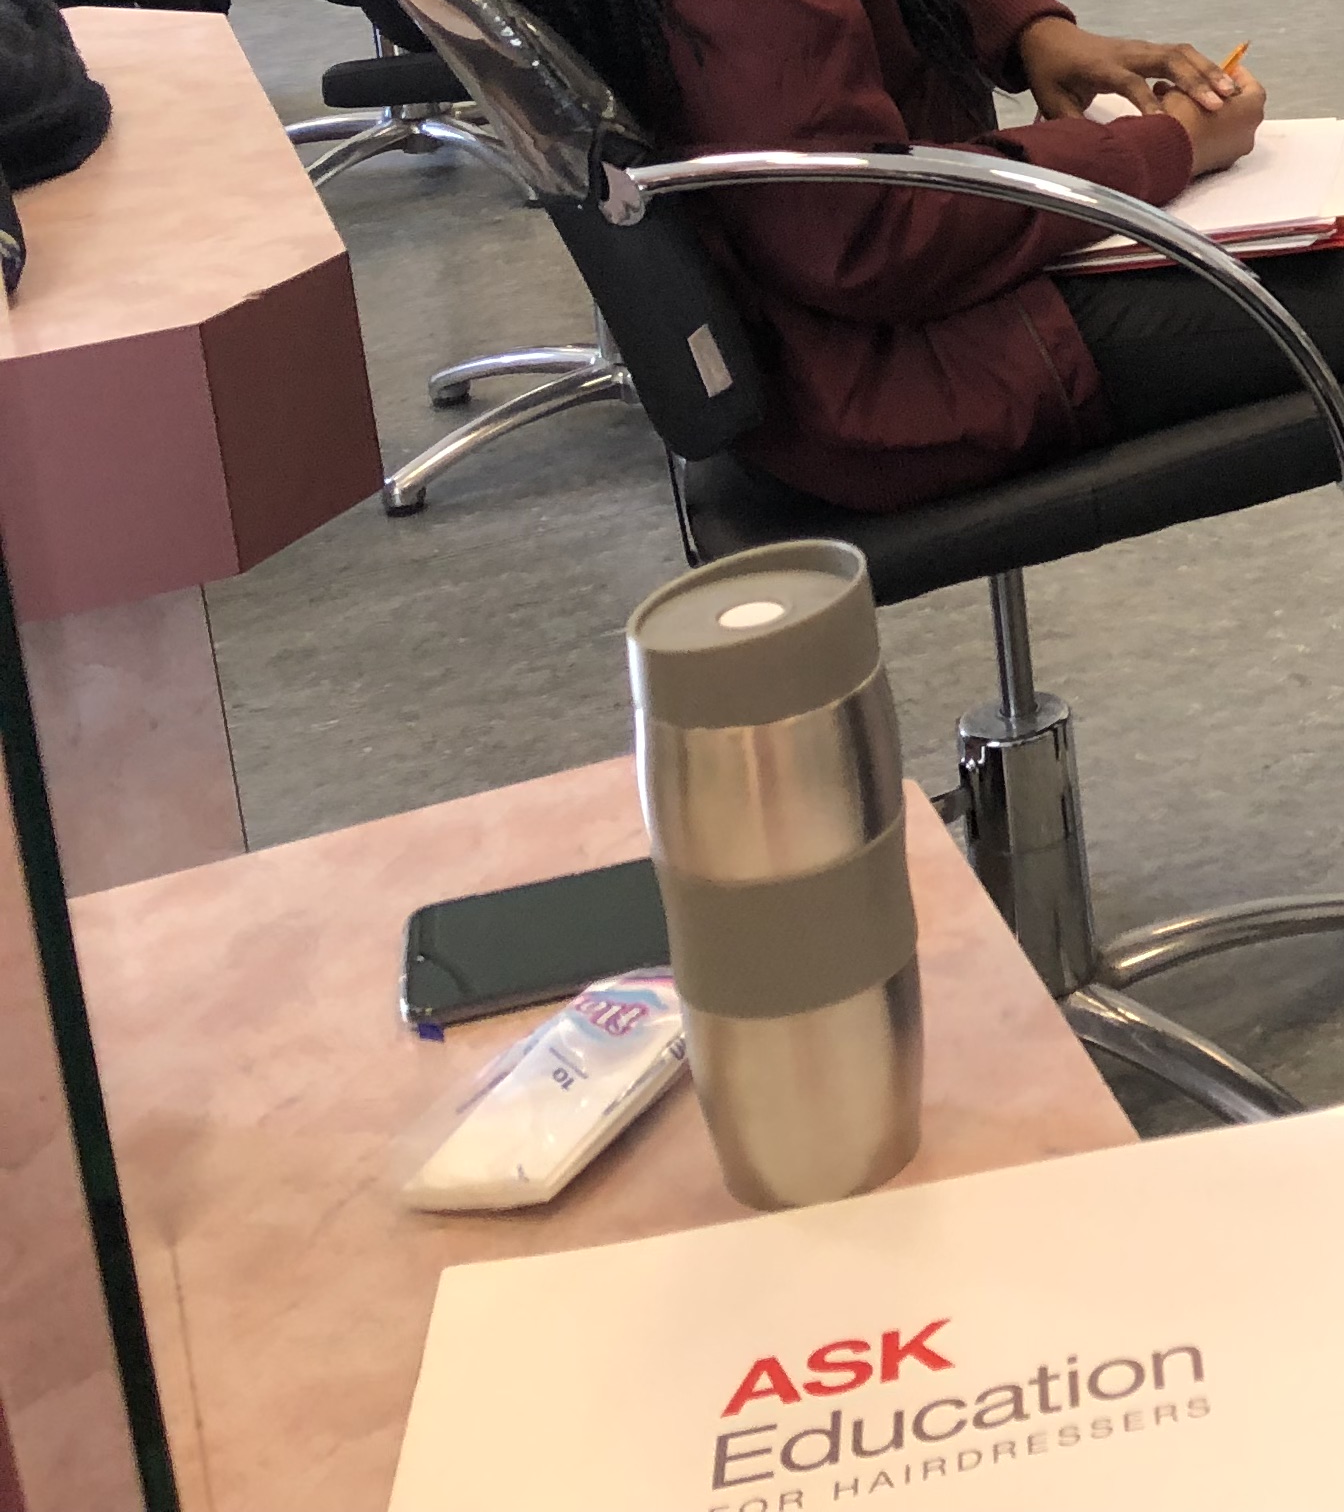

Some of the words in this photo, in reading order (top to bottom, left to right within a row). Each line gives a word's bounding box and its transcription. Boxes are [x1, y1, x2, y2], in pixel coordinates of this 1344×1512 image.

[552, 1067, 576, 1090] 10
[712, 1345, 1205, 1492] Education
[720, 1317, 956, 1418] ASK
[833, 1396, 1213, 1502] HAIRDRESSERS
